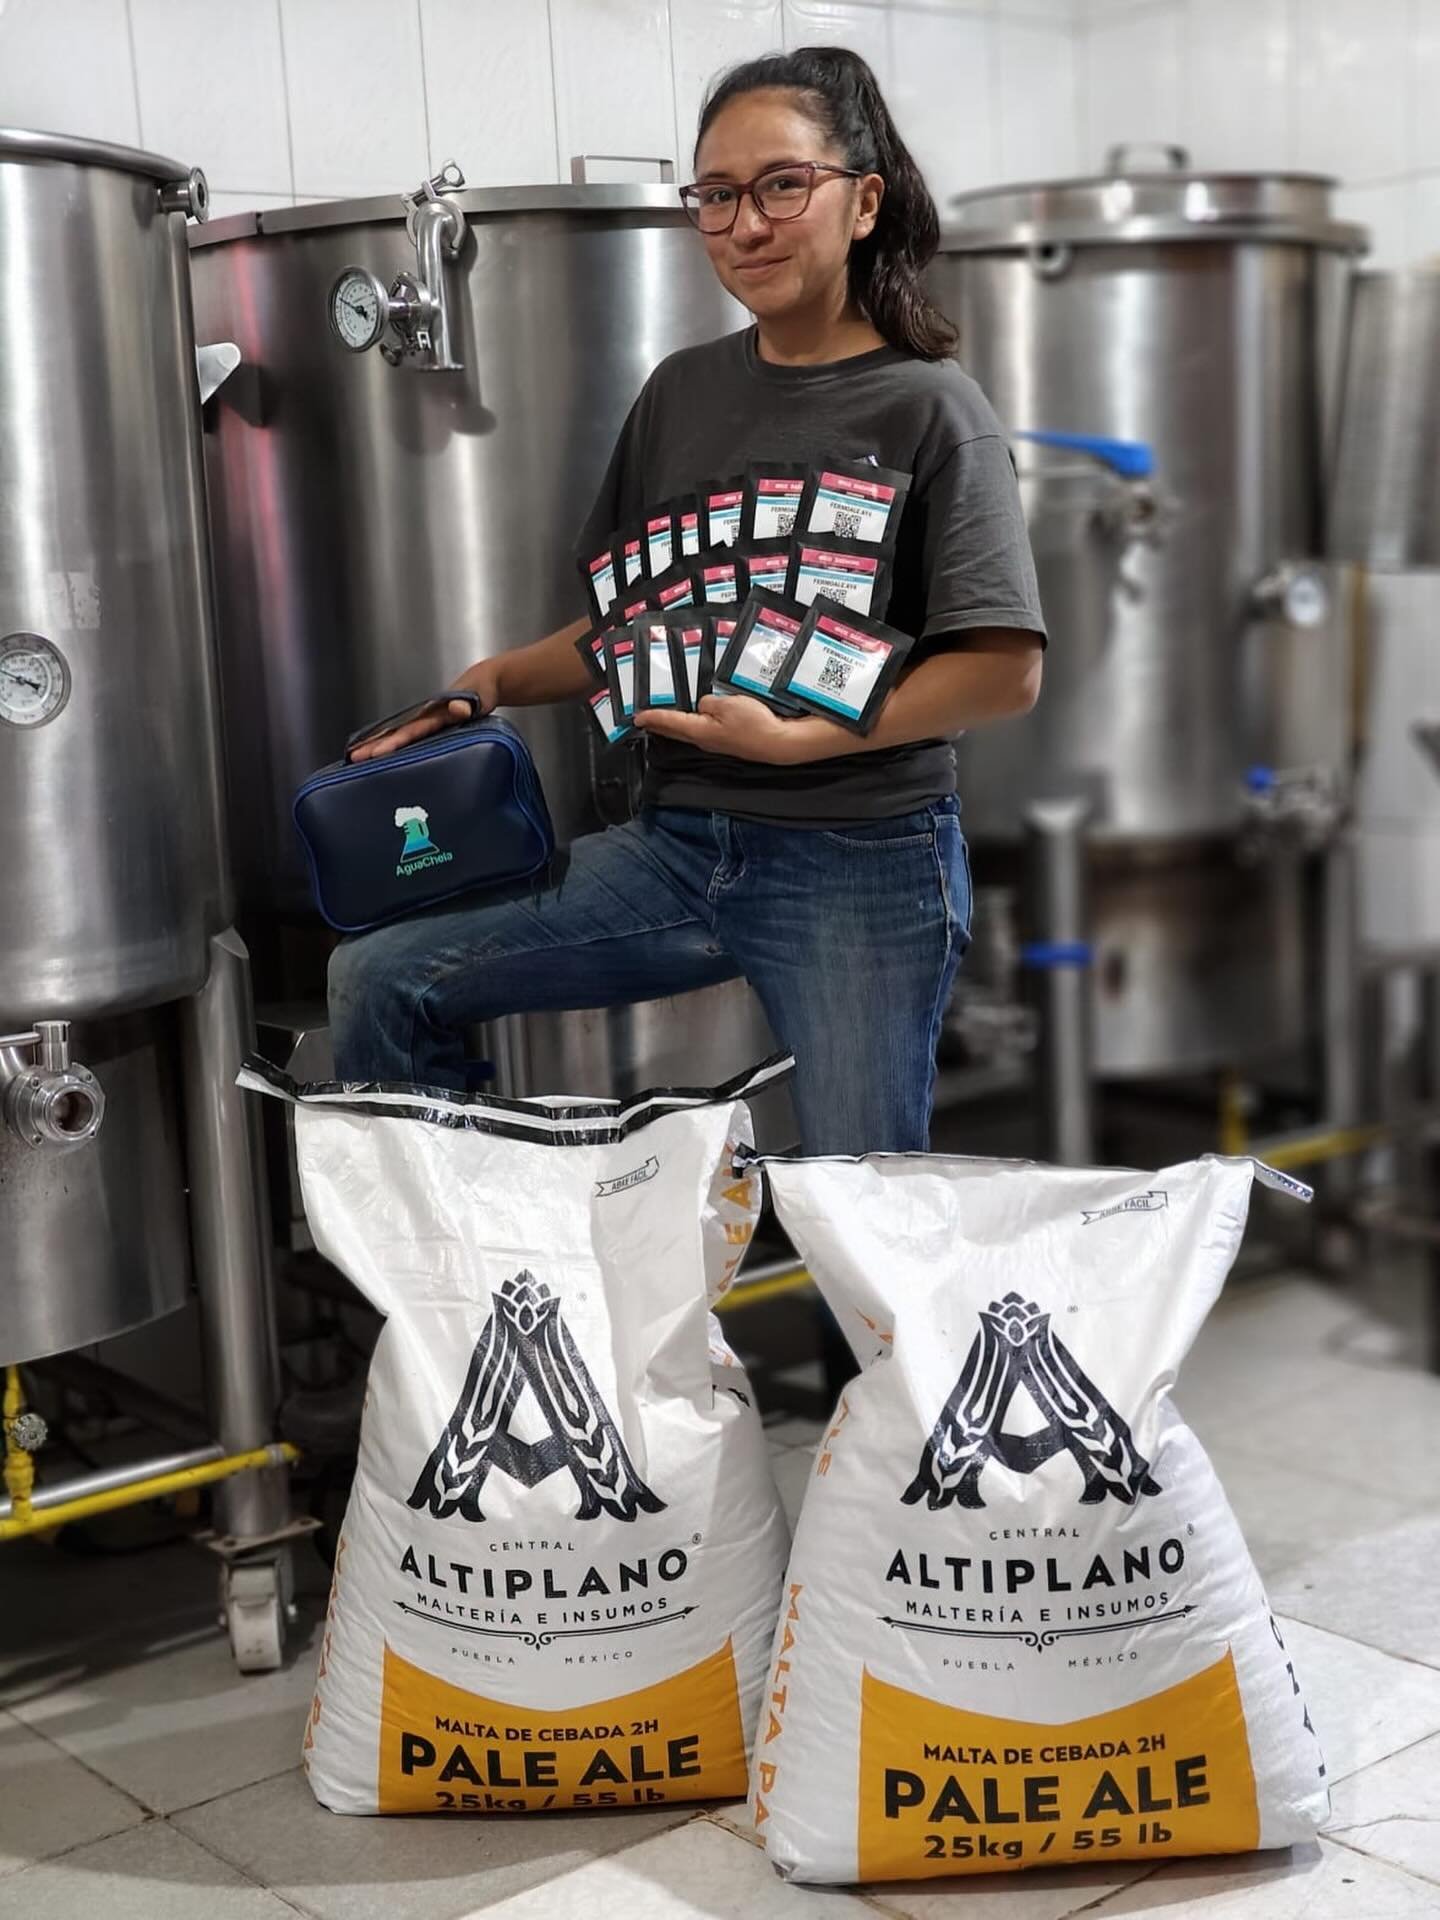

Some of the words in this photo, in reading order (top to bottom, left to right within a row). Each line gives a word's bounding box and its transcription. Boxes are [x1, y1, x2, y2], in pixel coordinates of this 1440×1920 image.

[489, 1540, 576, 1553] CENTRAL
[989, 1527, 1080, 1541] CENTRAL
[400, 1544, 688, 1599] ALTIPLANO
[885, 1538, 1185, 1595] ALTIPLANO
[417, 1592, 522, 1625] MALTERÍA
[537, 1612, 548, 1625] E
[562, 1597, 668, 1624] INSUMOS
[906, 1600, 1023, 1623] MALTERÍA
[1039, 1608, 1051, 1622] E
[1067, 1591, 1169, 1621] INSUMOS
[451, 1647, 515, 1665] PUEBLA
[564, 1650, 633, 1665] MÉXICO
[764, 1583, 804, 1744] MALTA
[943, 1658, 1015, 1671] PUEBLA
[1068, 1651, 1138, 1667] MÉXICO
[435, 1715, 500, 1742] MALTA
[505, 1727, 533, 1742] DE
[537, 1724, 625, 1742] CEBADA
[630, 1719, 659, 1736] 2H
[401, 1731, 558, 1788] PALE
[578, 1735, 702, 1786] ALE
[923, 1743, 998, 1765] MALTA
[1003, 1748, 1033, 1765] DE
[1039, 1740, 1132, 1763] CEBADA
[1137, 1733, 1166, 1754] 2H
[435, 1790, 527, 1811] 25kg
[572, 1790, 619, 1807] 55
[633, 1787, 666, 1804] lb
[884, 1768, 1061, 1825] PALE
[1082, 1754, 1210, 1819] ALE
[924, 1834, 1023, 1860] 25kg
[1039, 1832, 1056, 1854] /
[1072, 1828, 1122, 1850] 55
[1138, 1822, 1172, 1845] lb
